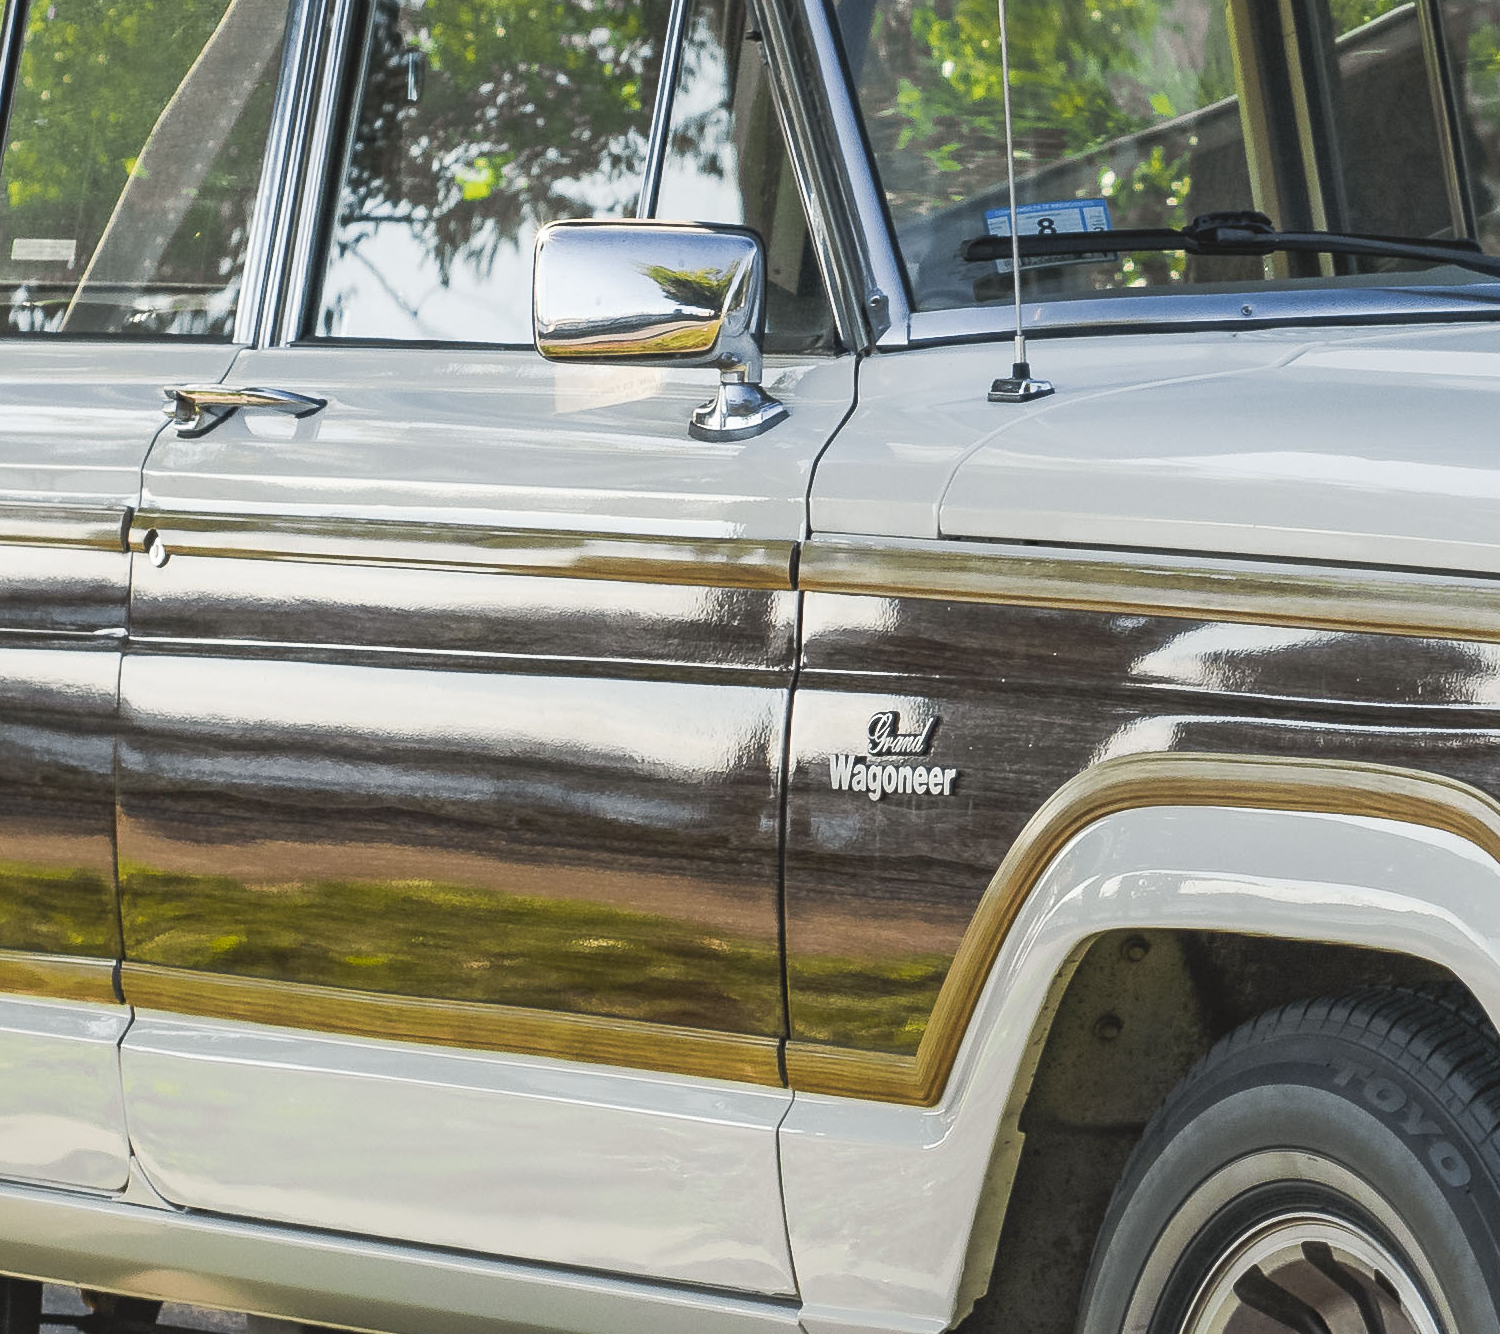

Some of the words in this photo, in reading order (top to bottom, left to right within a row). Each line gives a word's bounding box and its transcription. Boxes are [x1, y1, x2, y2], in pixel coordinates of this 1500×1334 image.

[867, 712, 934, 754] Grand
[829, 754, 957, 801] Wagoneer
[1329, 1055, 1472, 1188] TOYO
